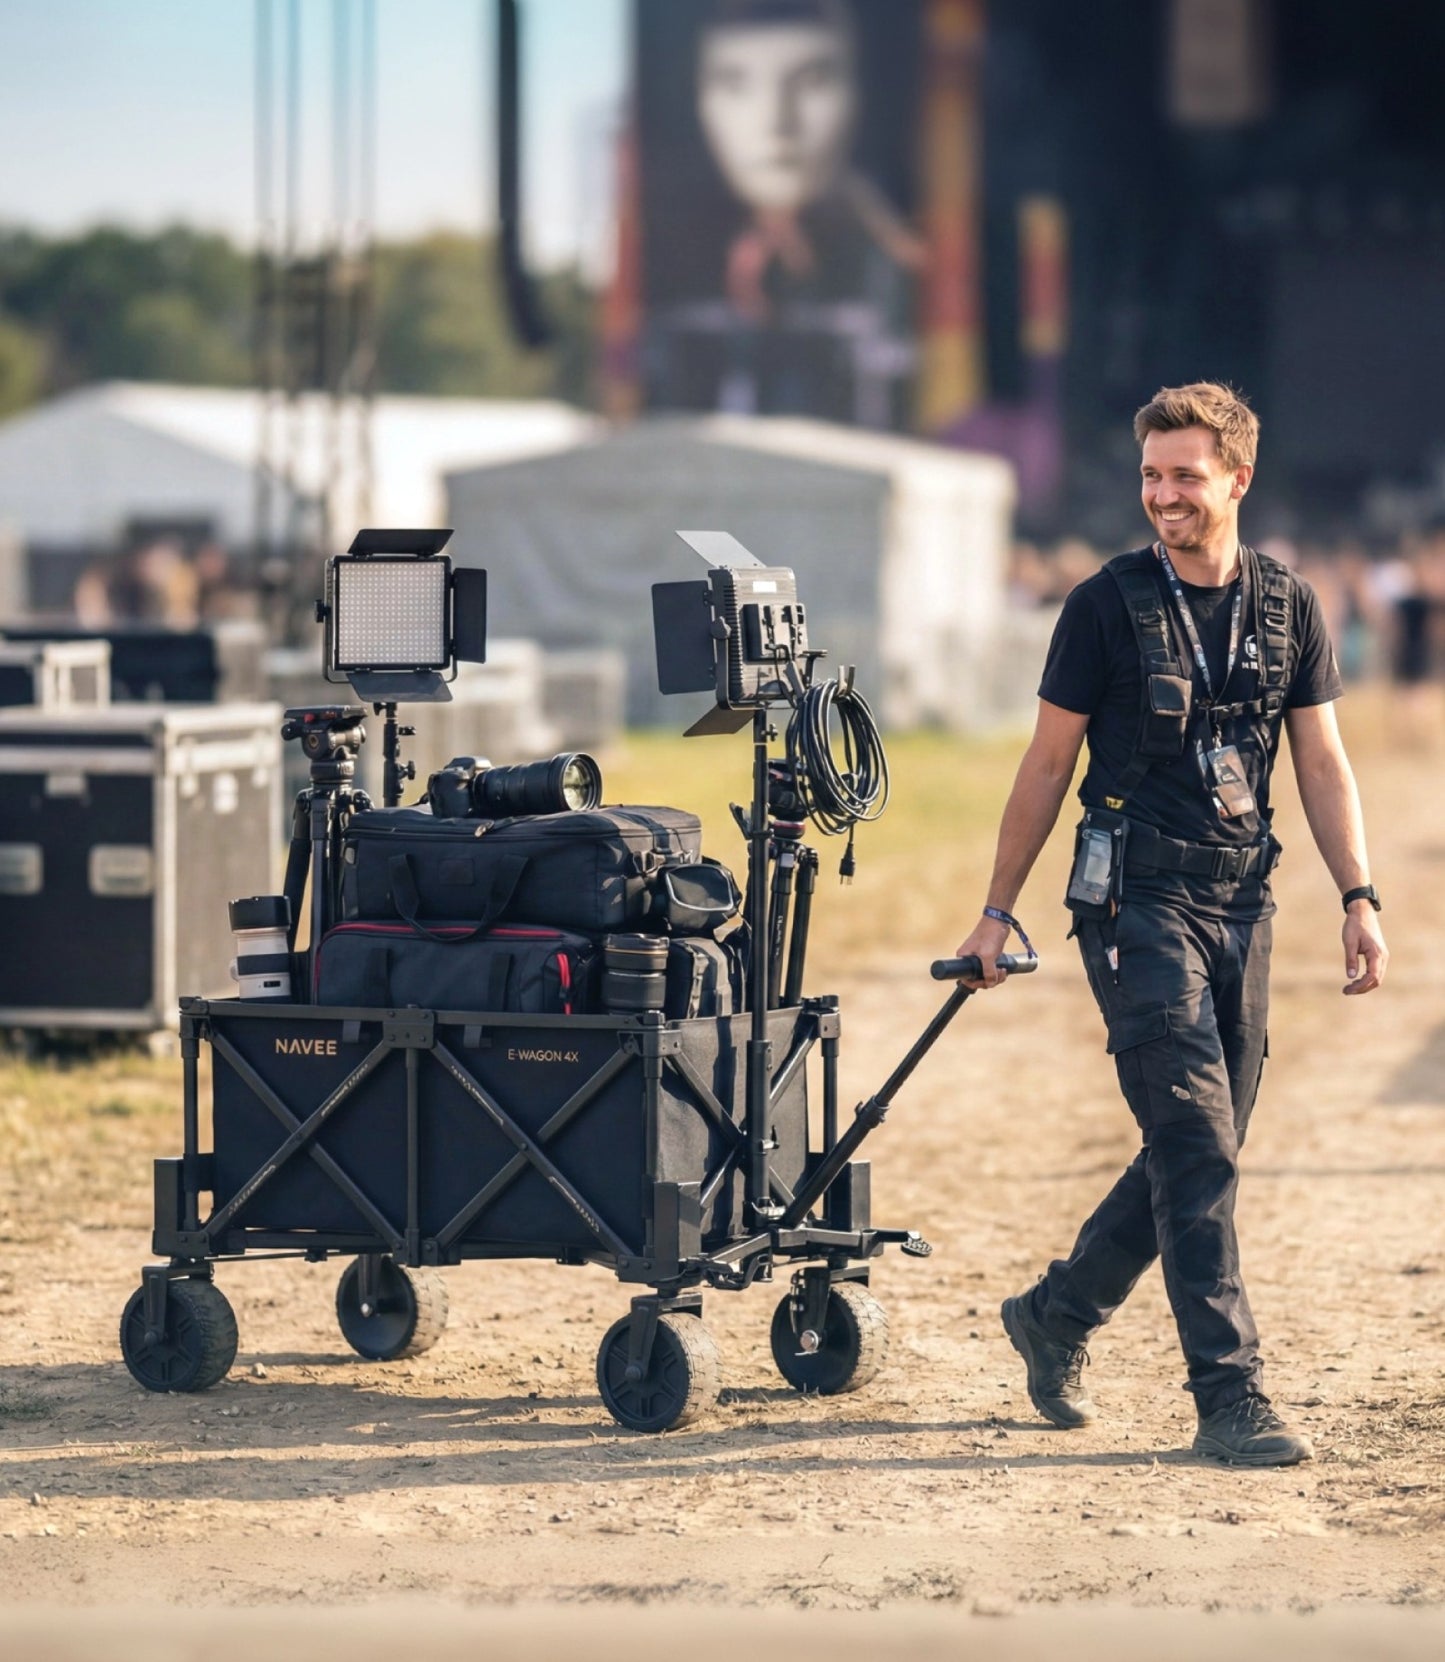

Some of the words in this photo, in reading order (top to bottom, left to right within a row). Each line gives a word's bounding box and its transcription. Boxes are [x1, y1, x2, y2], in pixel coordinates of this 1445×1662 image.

[275, 1038, 337, 1056] NAVEE
[508, 1048, 562, 1062] E-WAGON
[564, 1050, 579, 1063] 4X
